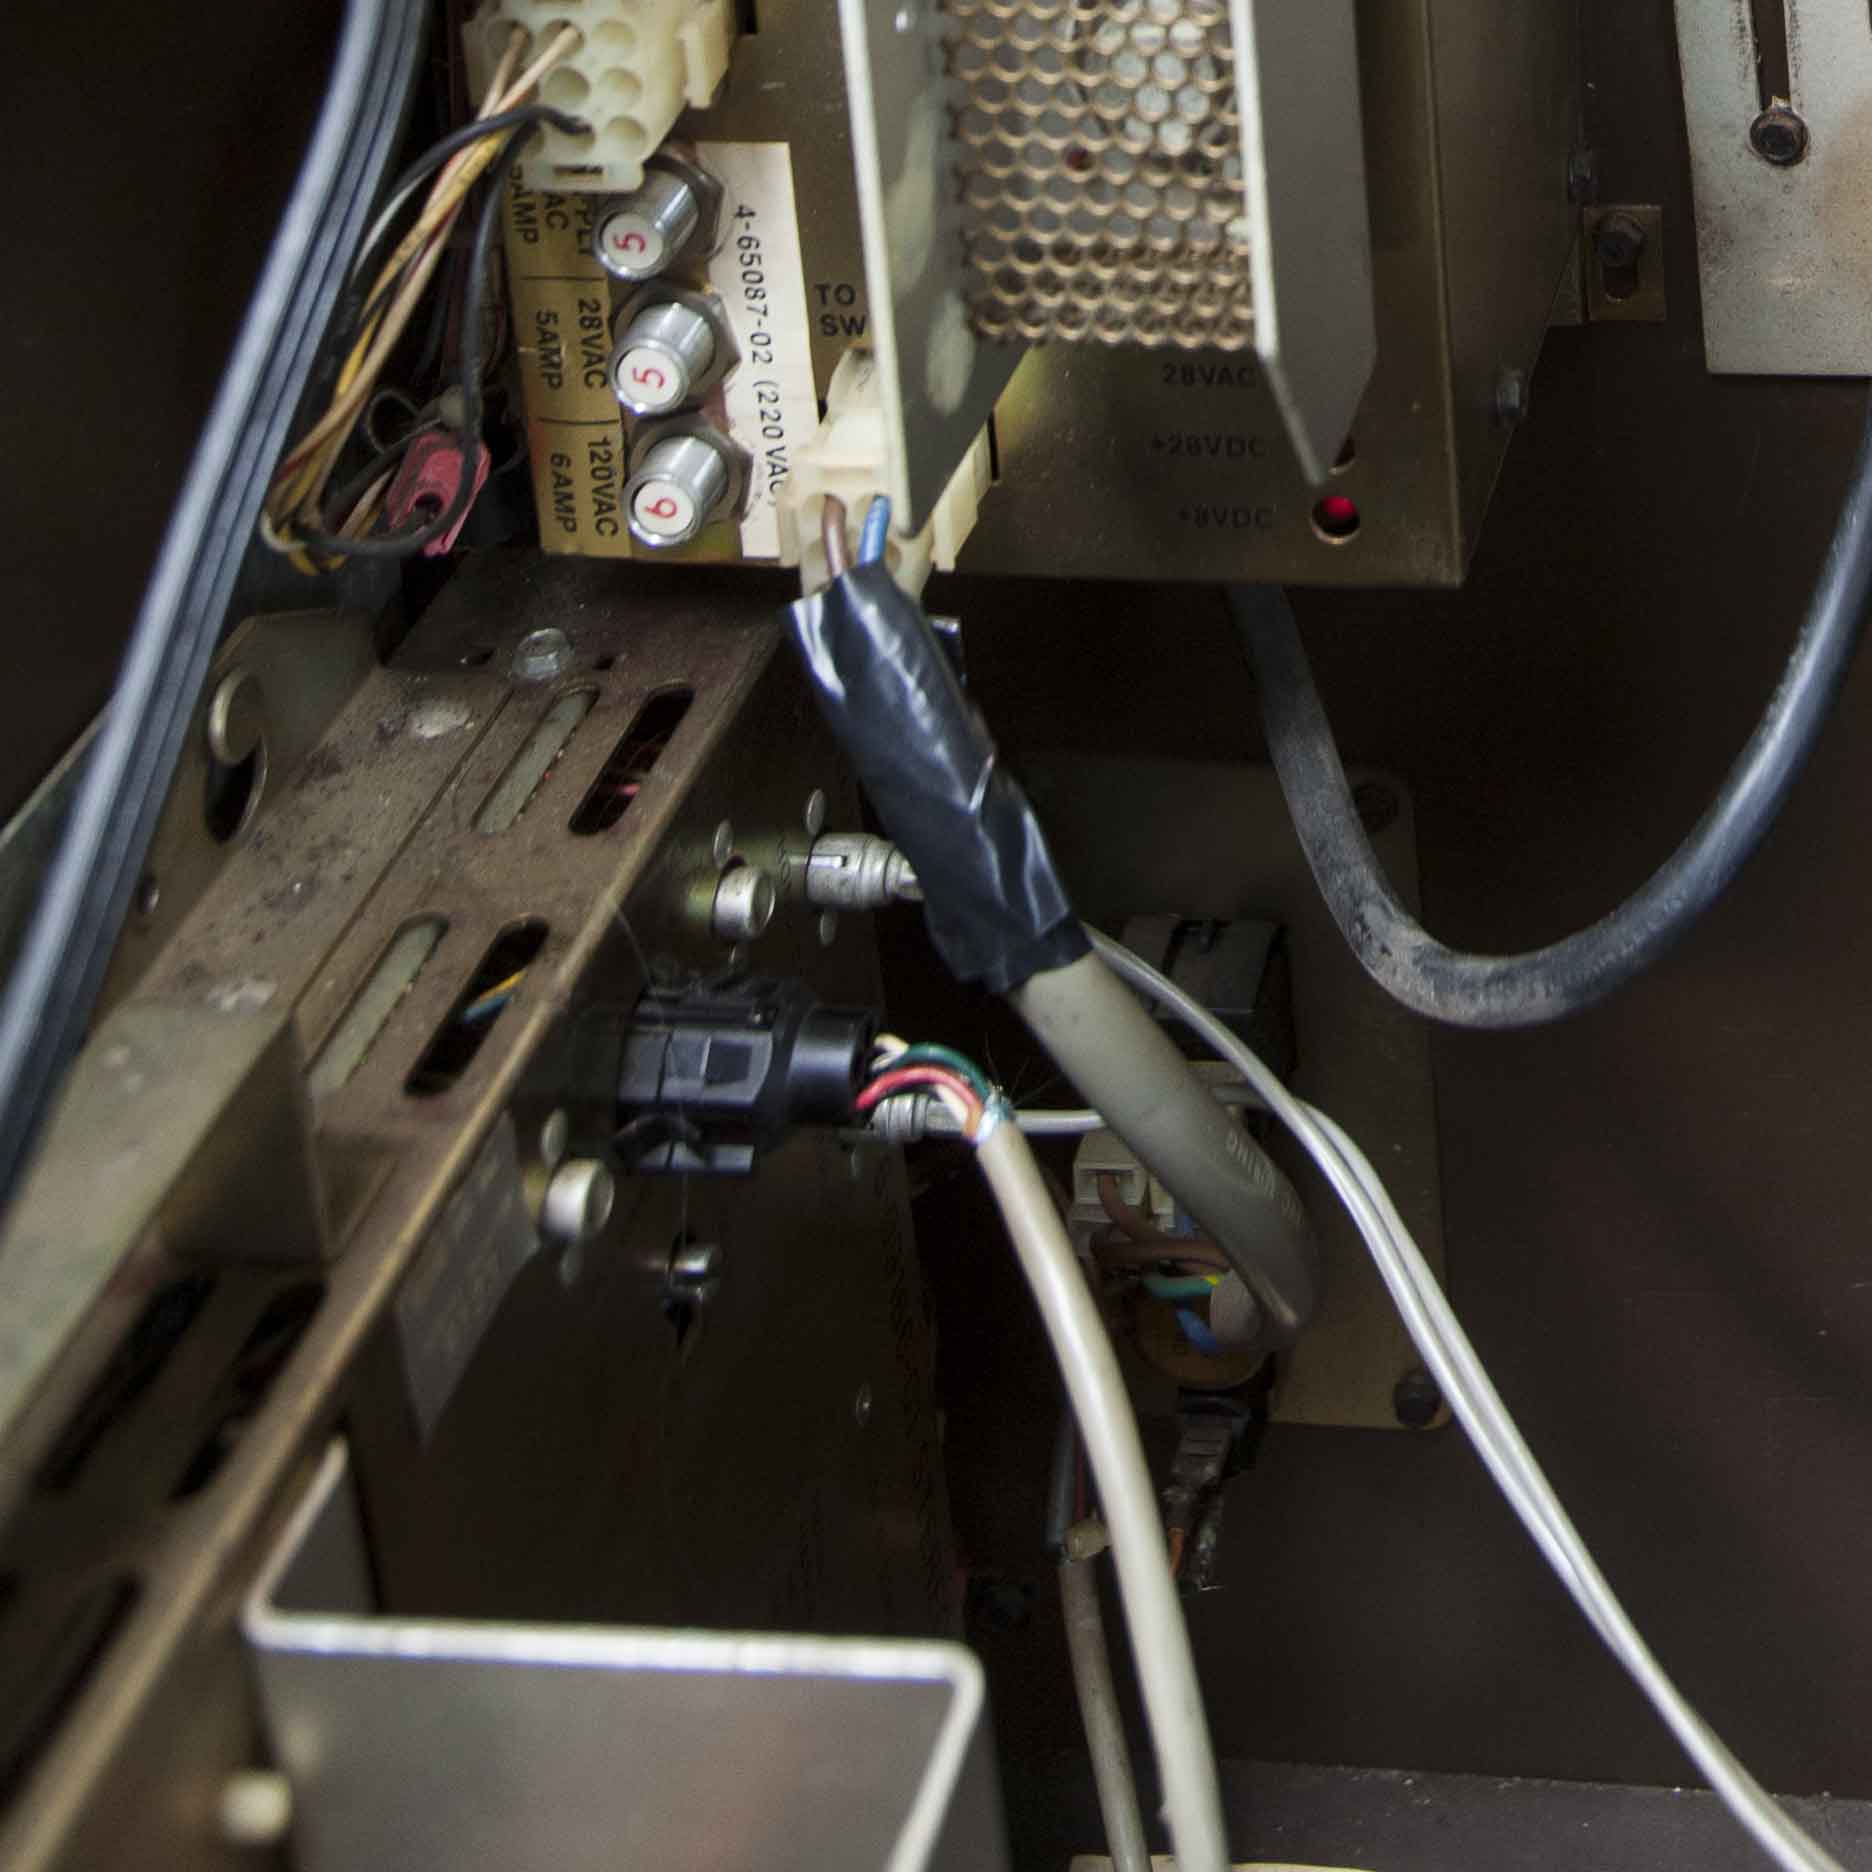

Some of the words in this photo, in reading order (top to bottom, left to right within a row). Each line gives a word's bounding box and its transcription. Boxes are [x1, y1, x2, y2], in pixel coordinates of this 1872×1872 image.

[613, 232, 647, 253] 5
[736, 205, 772, 364] 4-65087-02
[816, 284, 856, 304] TO
[536, 312, 563, 390] 5AMP
[578, 299, 608, 389] 28VAC
[633, 368, 665, 389] 5
[551, 453, 576, 533] 6AMP
[588, 434, 618, 537] 120VAC
